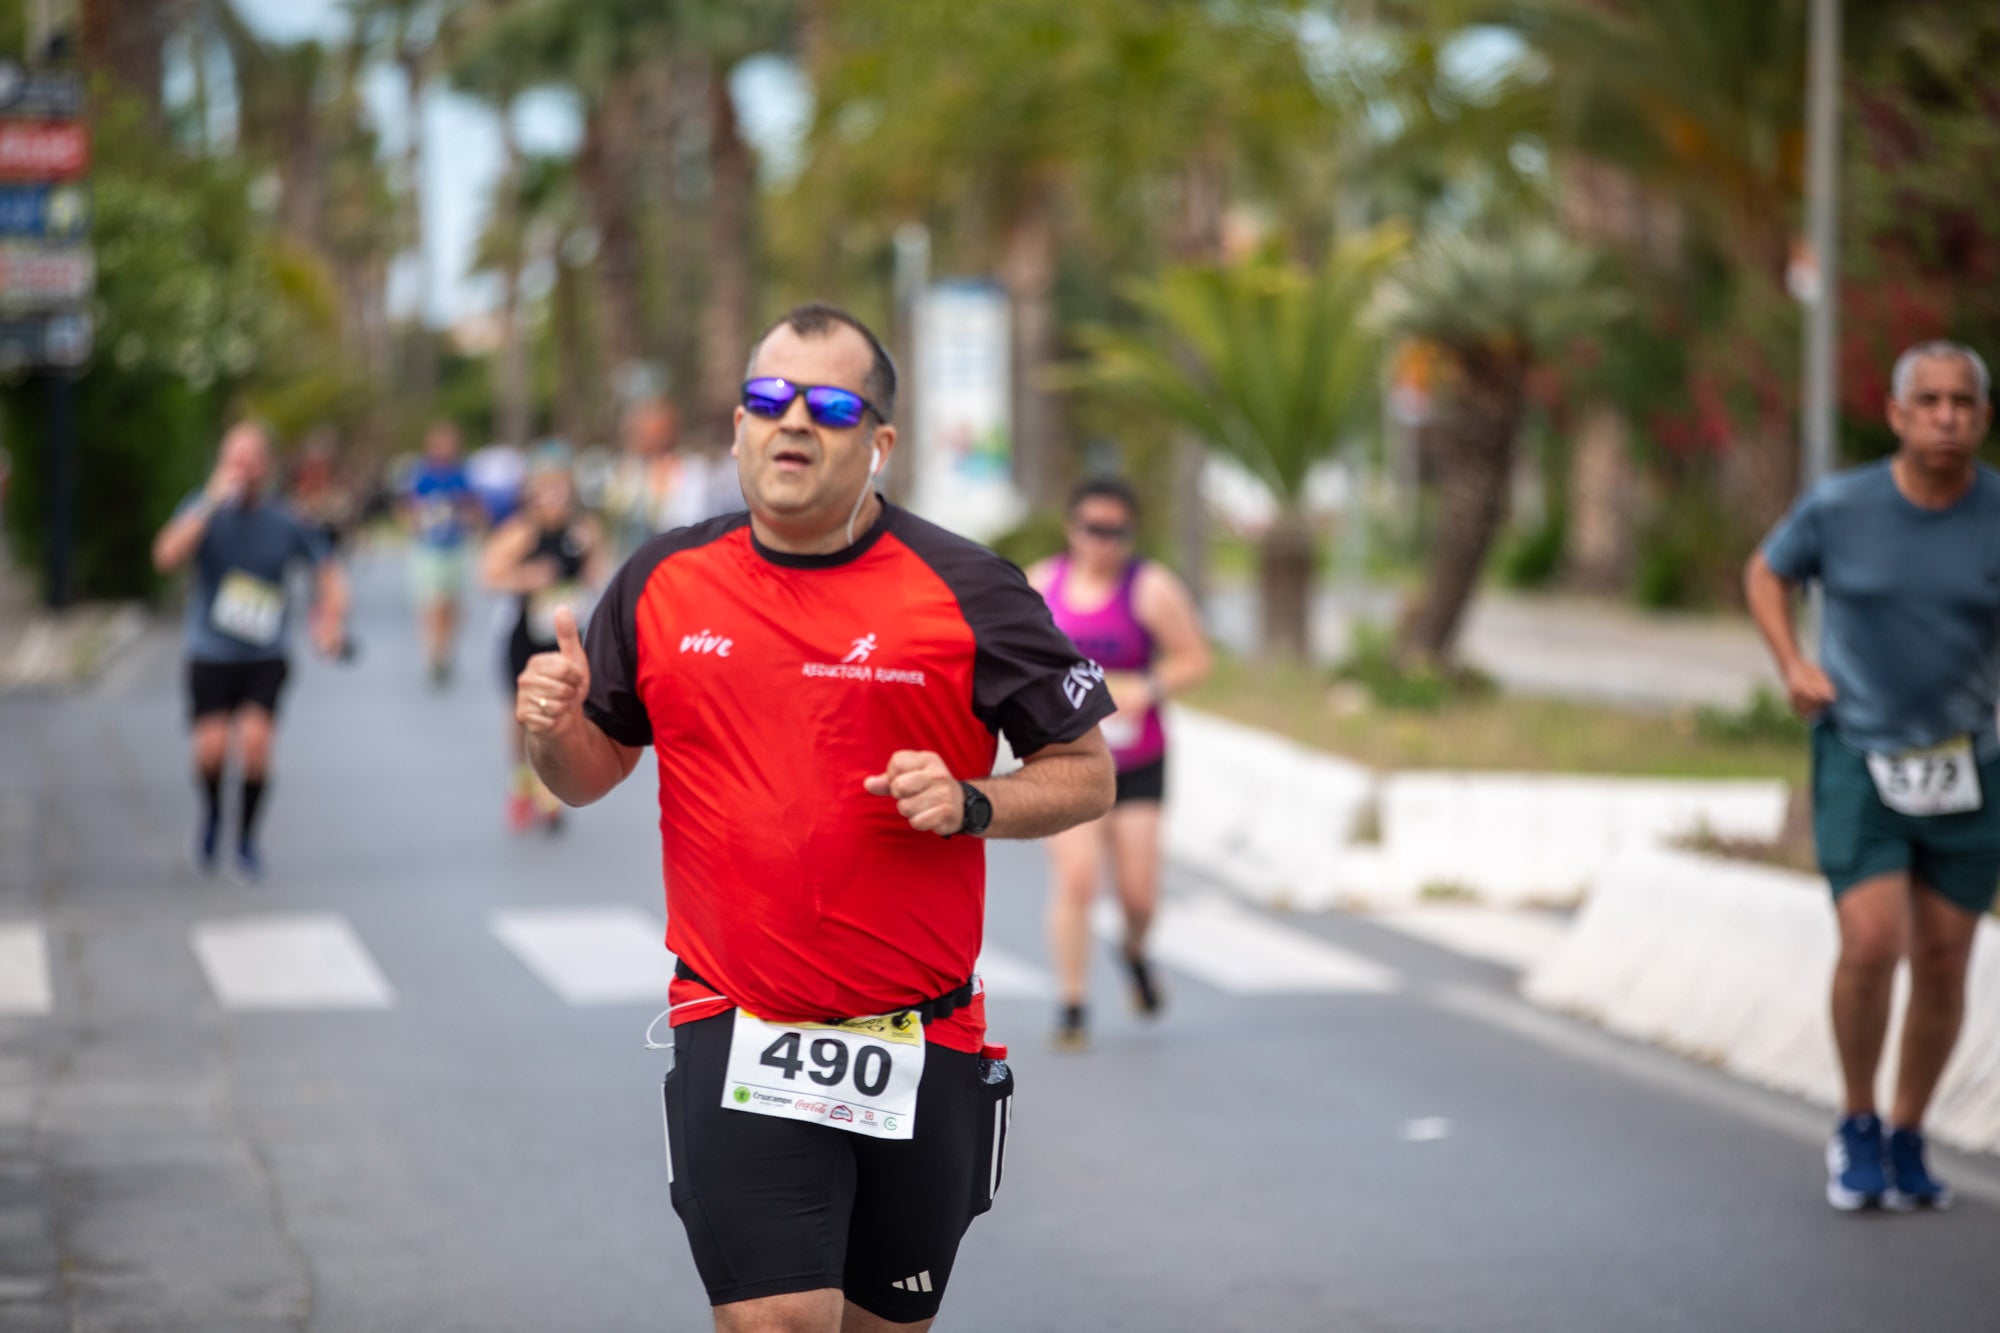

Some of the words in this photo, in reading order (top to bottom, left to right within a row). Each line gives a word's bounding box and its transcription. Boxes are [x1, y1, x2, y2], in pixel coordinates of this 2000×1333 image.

[874, 666, 926, 687] RUNNER
[760, 1032, 892, 1097] 490
[753, 1091, 793, 1105] Cruzcampo
